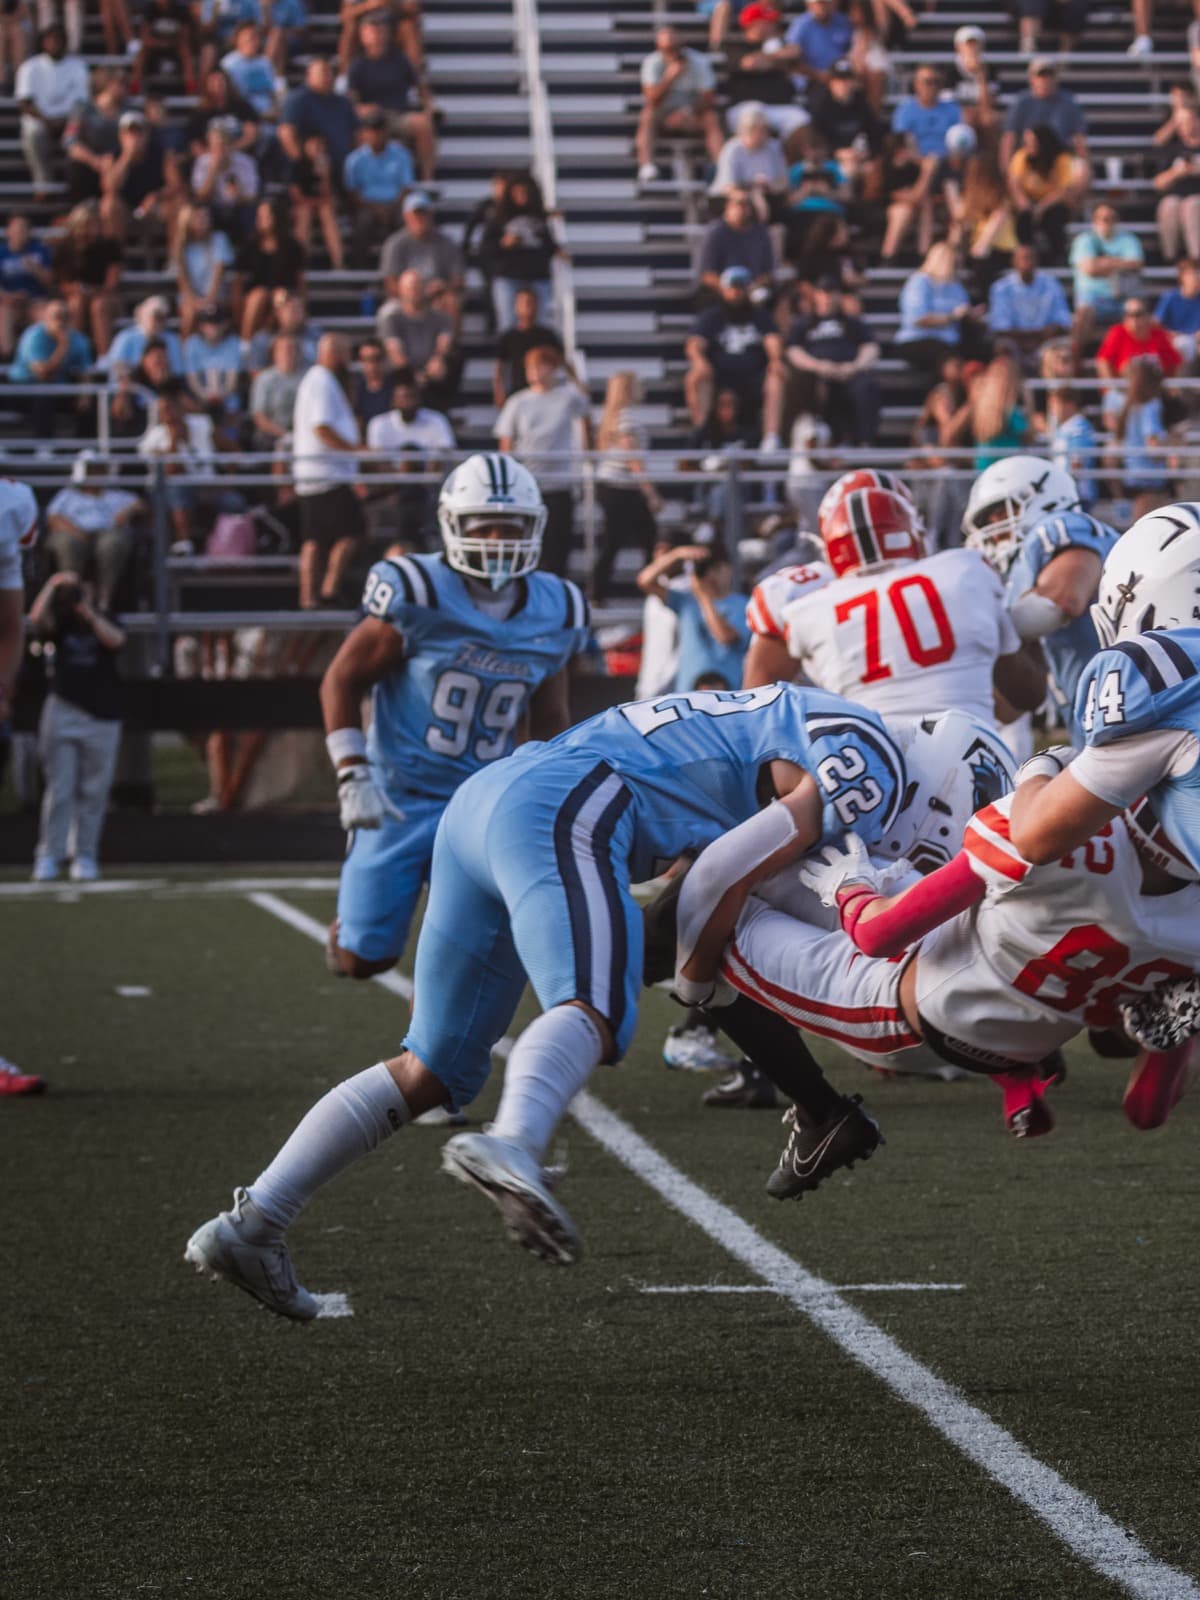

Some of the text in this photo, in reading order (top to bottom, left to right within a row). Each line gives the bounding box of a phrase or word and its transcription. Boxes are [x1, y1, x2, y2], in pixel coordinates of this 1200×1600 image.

[834, 573, 957, 684] 70
[425, 669, 528, 762] 99
[816, 745, 885, 826] 22
